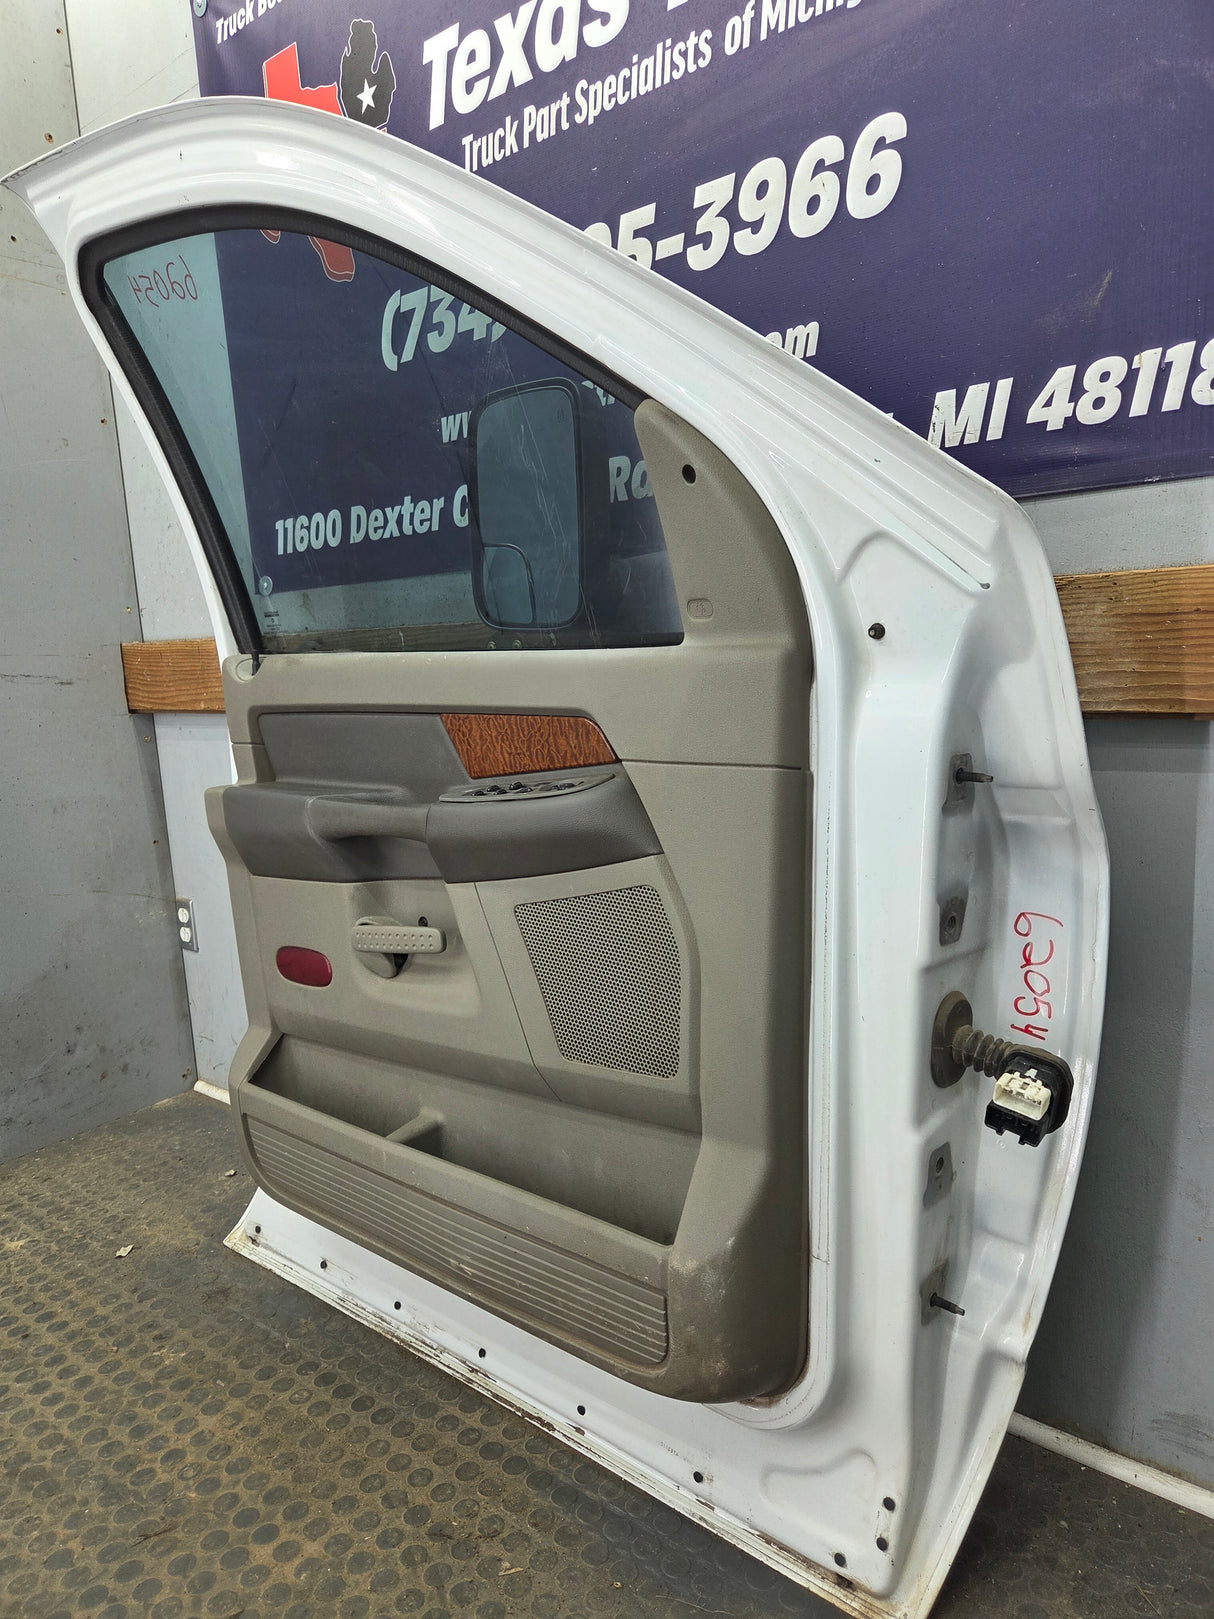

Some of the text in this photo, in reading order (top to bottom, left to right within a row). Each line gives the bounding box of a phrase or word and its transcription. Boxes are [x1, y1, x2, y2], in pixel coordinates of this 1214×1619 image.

[215, 0, 254, 44] Truck
[422, 0, 629, 131] Texas
[461, 115, 517, 172] Truck
[523, 90, 571, 150] Part
[574, 28, 713, 126] Specialists
[724, 3, 755, 56] of
[275, 509, 341, 555] 11600
[349, 494, 445, 544] Dexter
[927, 377, 1014, 450] MI
